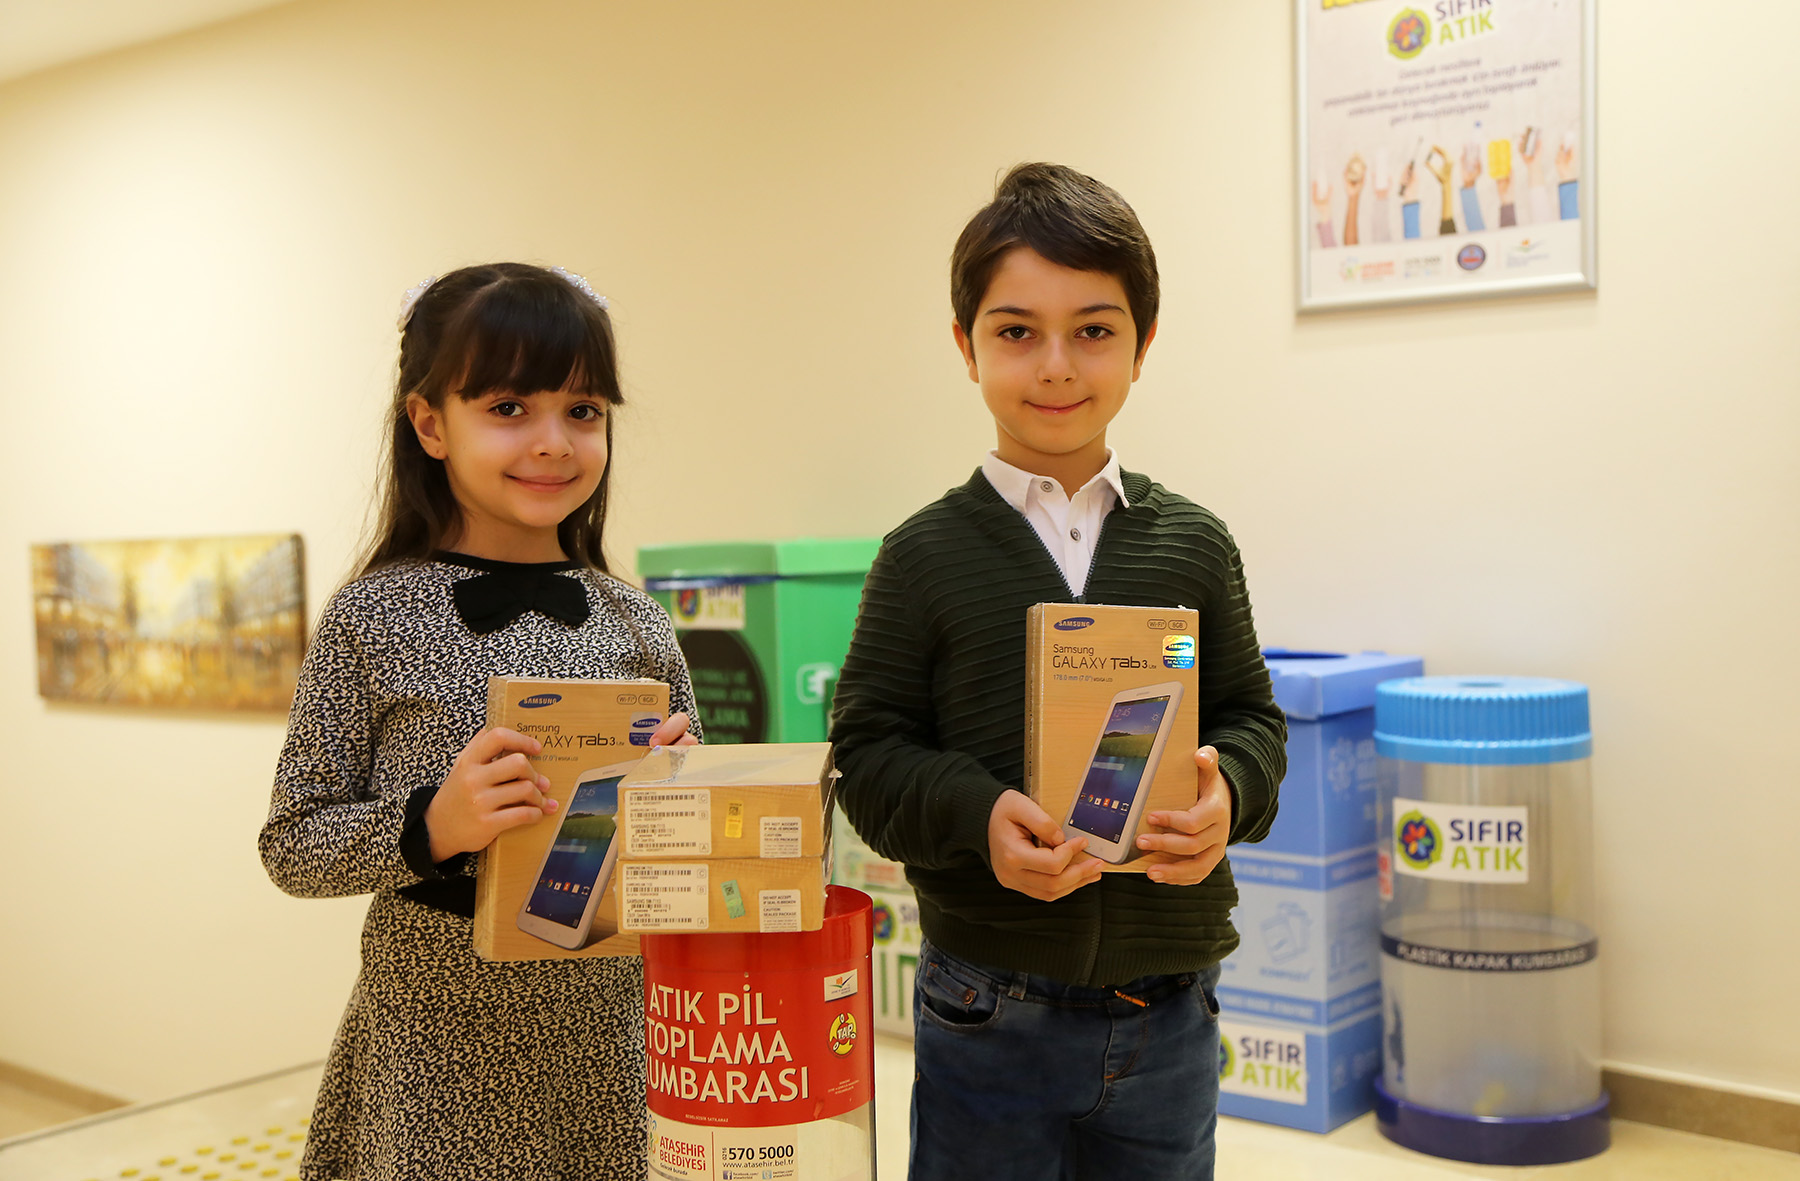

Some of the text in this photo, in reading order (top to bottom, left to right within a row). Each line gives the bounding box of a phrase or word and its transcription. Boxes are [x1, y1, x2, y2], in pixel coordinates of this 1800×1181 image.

[1439, 11, 1494, 45] ATIK
[1058, 619, 1090, 628] SAMSUNG
[1053, 644, 1094, 655] Samsung
[1052, 656, 1107, 669] GALAXY
[1110, 656, 1140, 670] Tab
[1142, 660, 1148, 668] 3
[523, 697, 557, 705] SAMSUNG
[516, 723, 560, 735] Samsung
[577, 733, 608, 748] Tab
[609, 737, 616, 746] 3
[1450, 819, 1523, 843] SIFIR
[1450, 845, 1523, 871] ATIK
[1453, 952, 1510, 969] KAPAK
[650, 982, 777, 1026] ATIK PİL
[646, 1015, 793, 1065] TOPLAMA
[837, 1023, 853, 1040] TAP
[1240, 1036, 1302, 1066] SIFIR
[1241, 1061, 1302, 1094] ATIK
[660, 1136, 705, 1158] ATAŞEHİR
[729, 1147, 755, 1160] 570
[759, 1145, 794, 1160] 5000
[660, 1149, 706, 1171] BELEDİYESİ
[722, 1159, 794, 1168] www.atasehir.bel.tr
